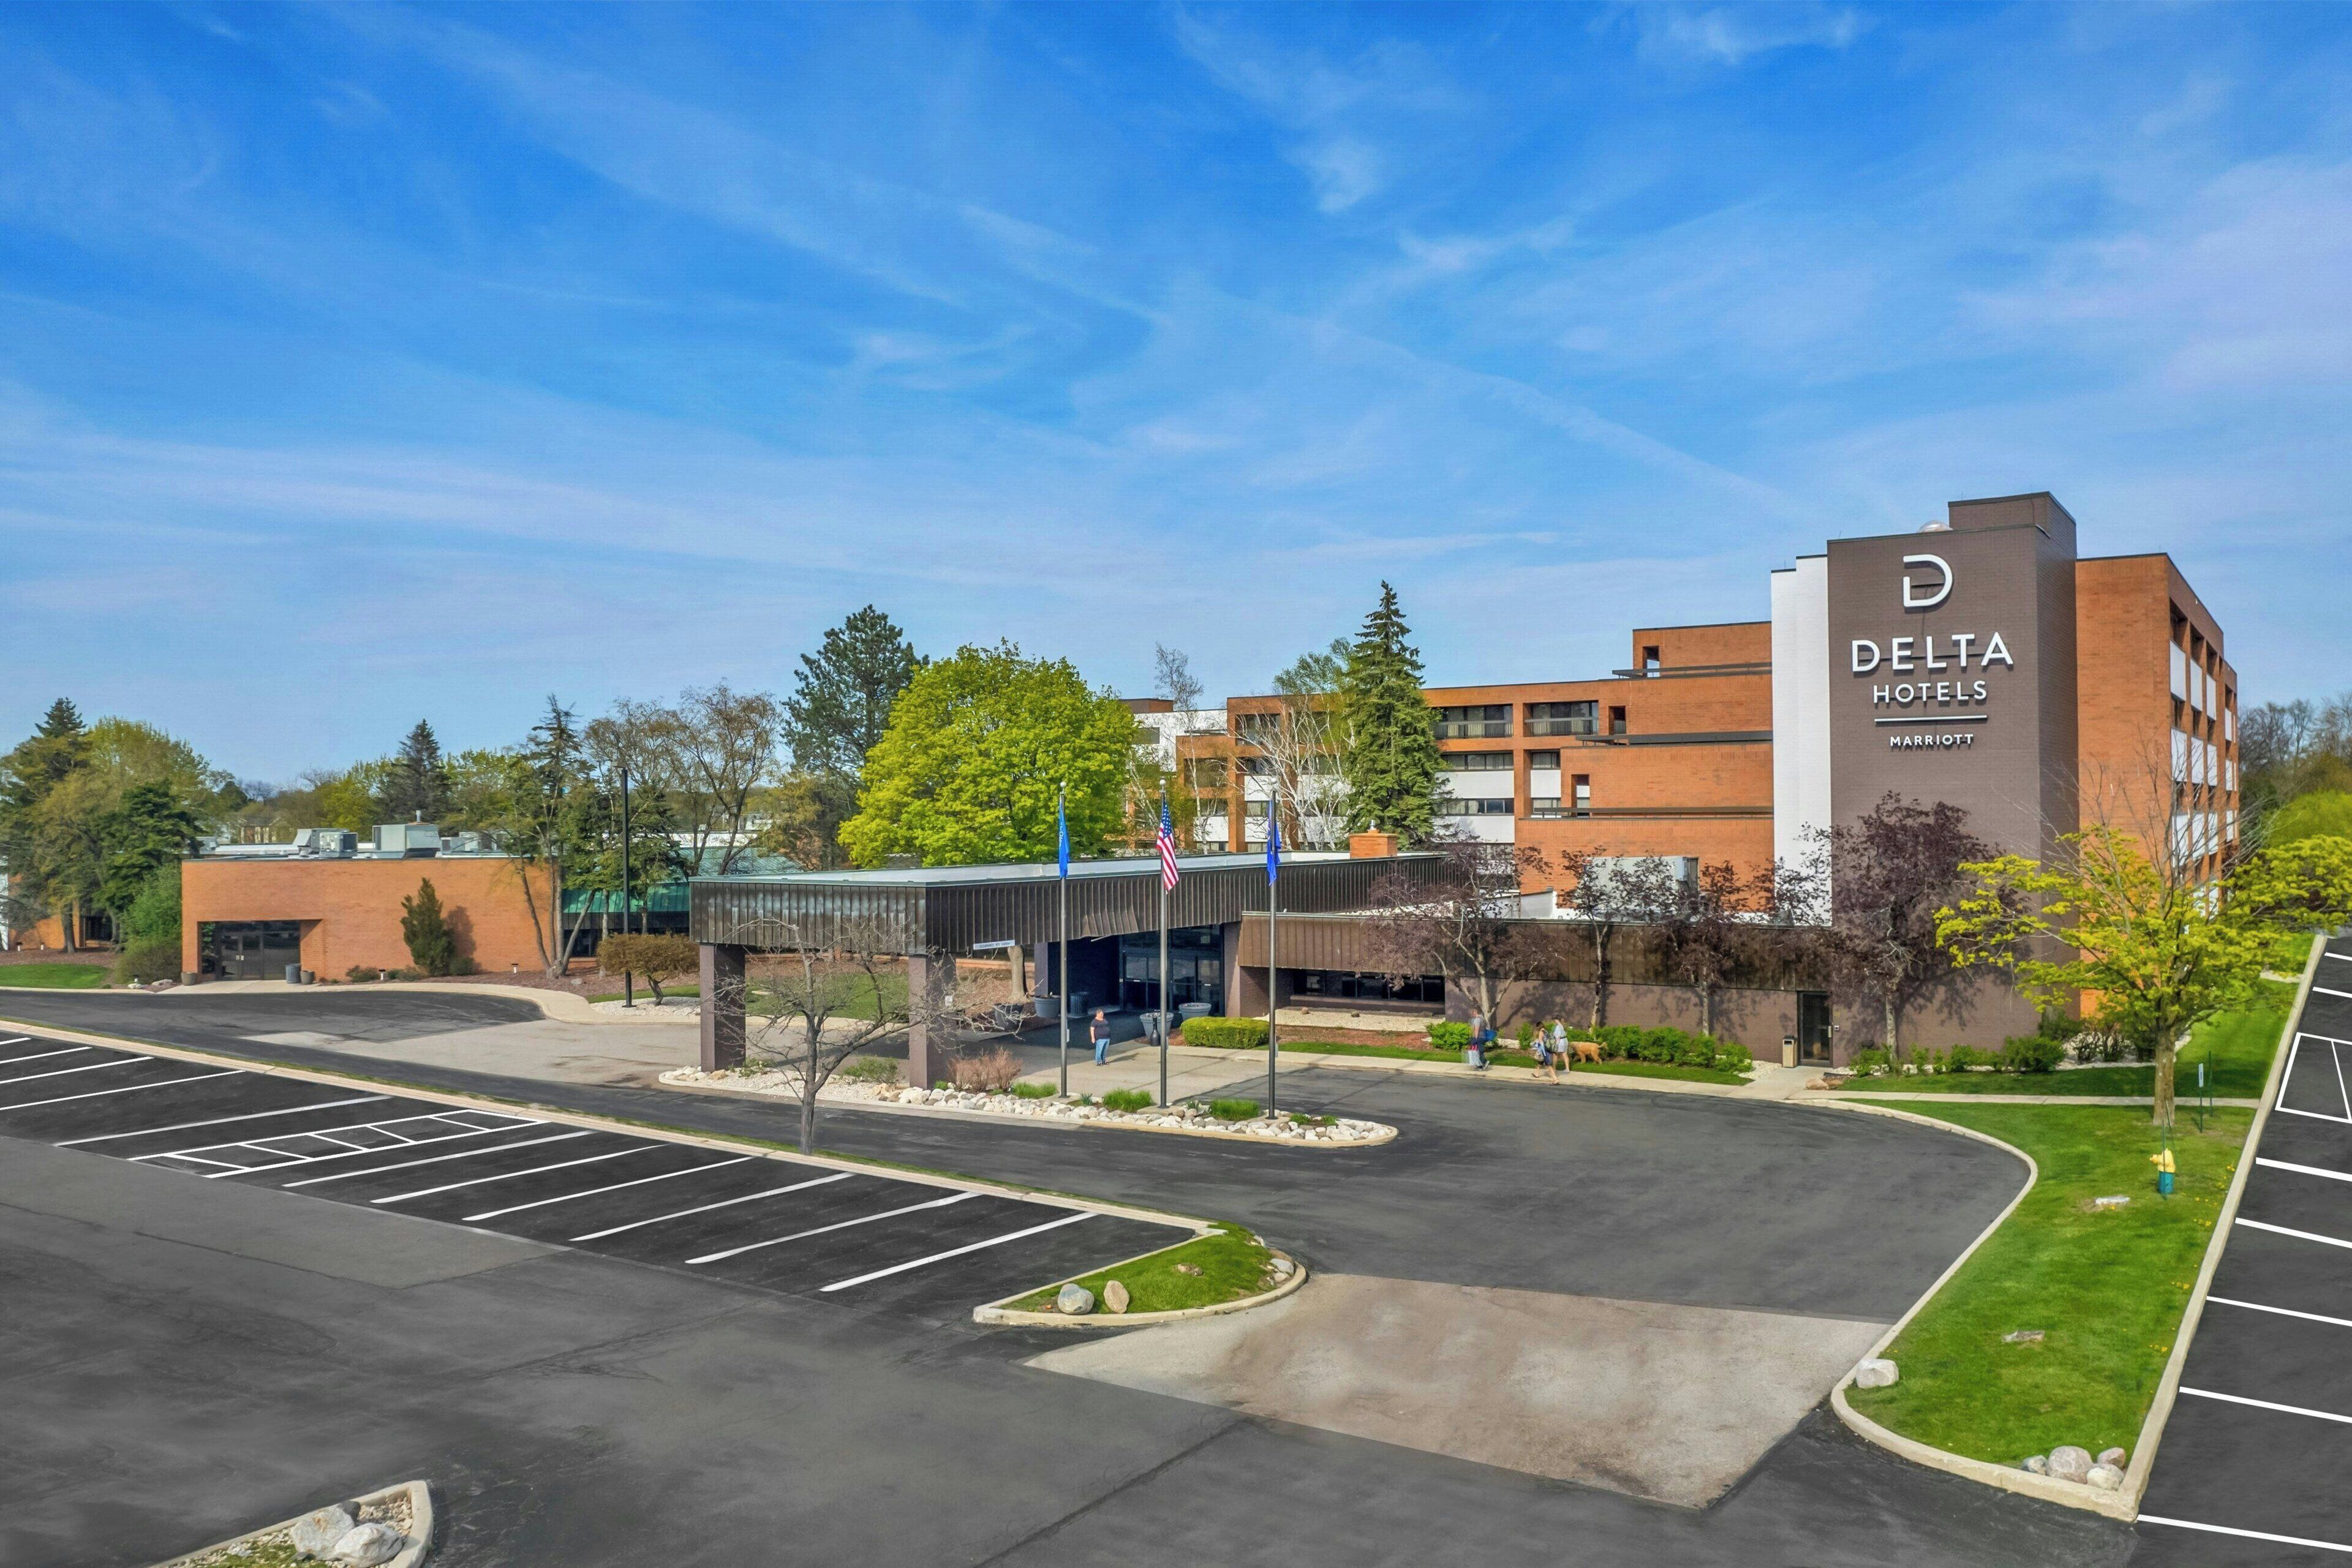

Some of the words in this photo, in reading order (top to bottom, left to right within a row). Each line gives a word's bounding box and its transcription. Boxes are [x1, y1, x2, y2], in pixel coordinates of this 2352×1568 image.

[1852, 631, 2014, 672] DELTA
[1873, 680, 1987, 703] HOTELS
[1890, 734, 1973, 747] MARRIOTT
